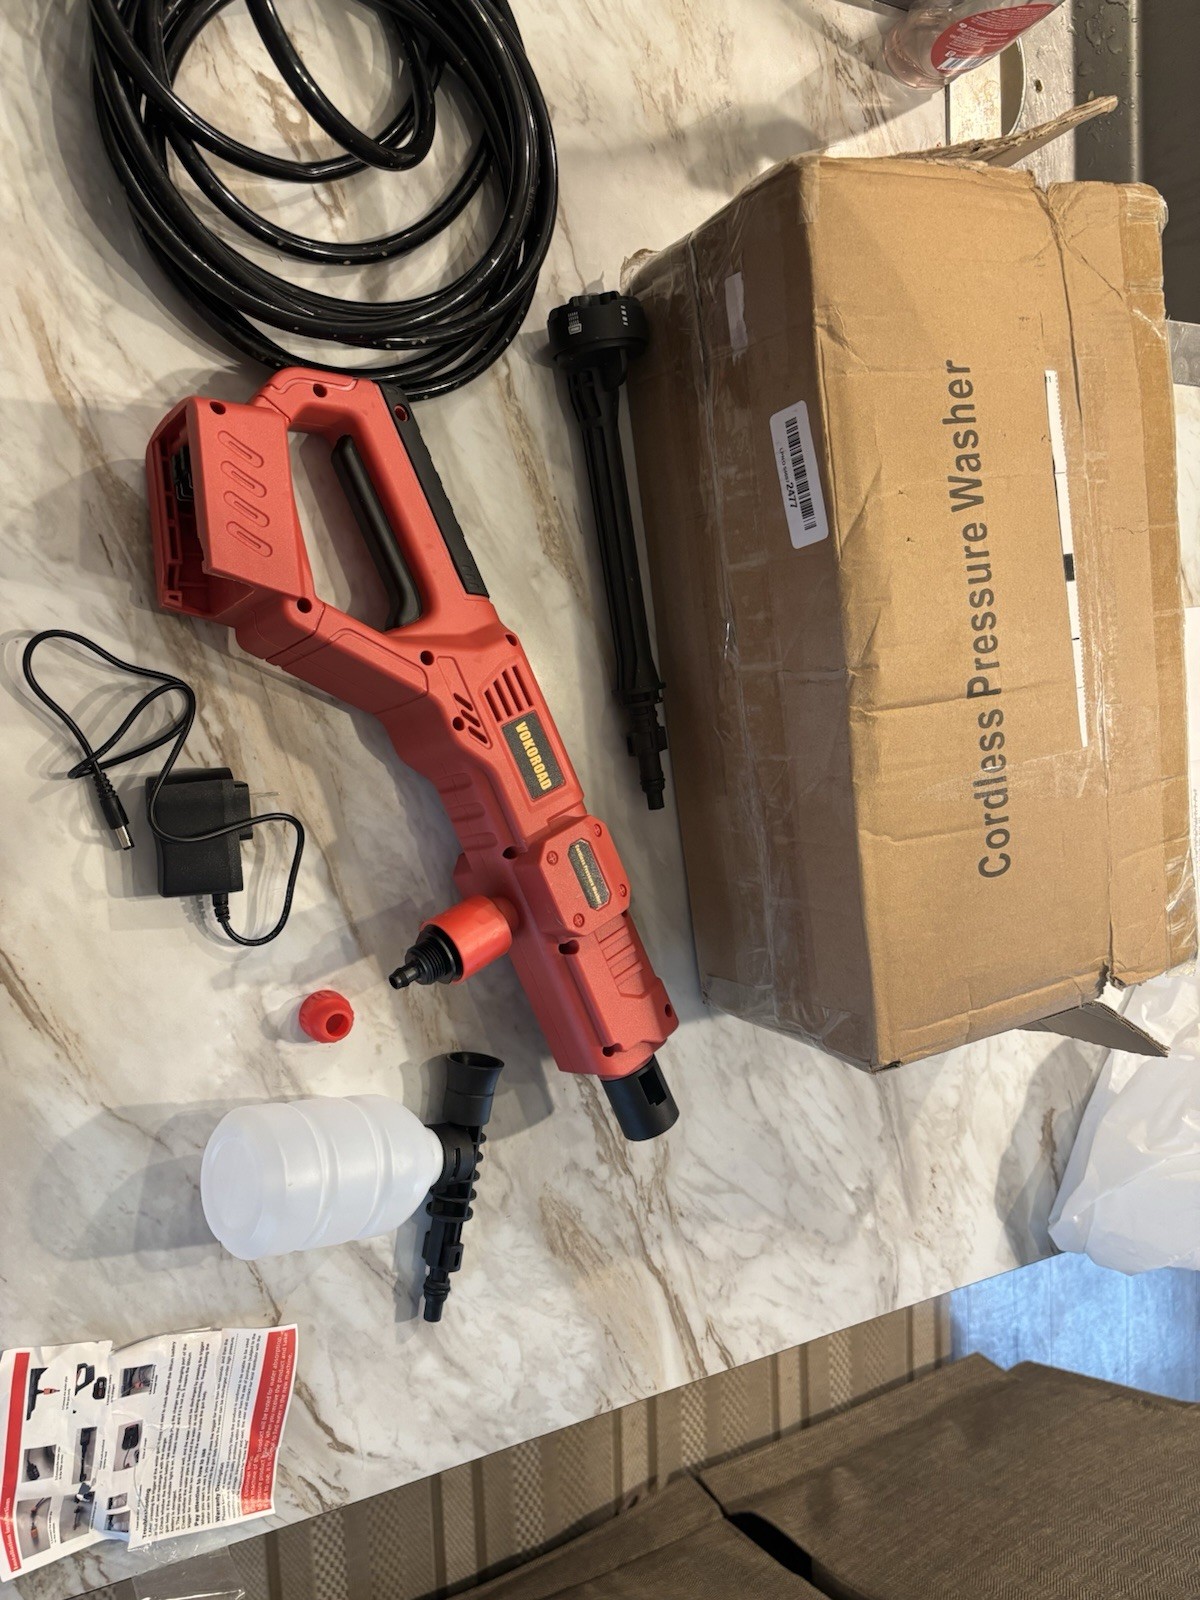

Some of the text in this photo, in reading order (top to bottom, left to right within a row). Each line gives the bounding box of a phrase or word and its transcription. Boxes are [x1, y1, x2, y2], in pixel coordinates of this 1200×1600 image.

[943, 359, 1011, 879] Cordless Pressure Washer
[515, 720, 552, 791] VOKOROAD
[255, 1430, 265, 1453] product
[263, 1396, 271, 1412] tested
[268, 1370, 276, 1387] water
[270, 1393, 279, 1413] receive
[276, 1360, 286, 1384] product
[275, 1410, 283, 1424] water
[215, 1462, 225, 1492] Description
[142, 1488, 151, 1540] Troubleshooting
